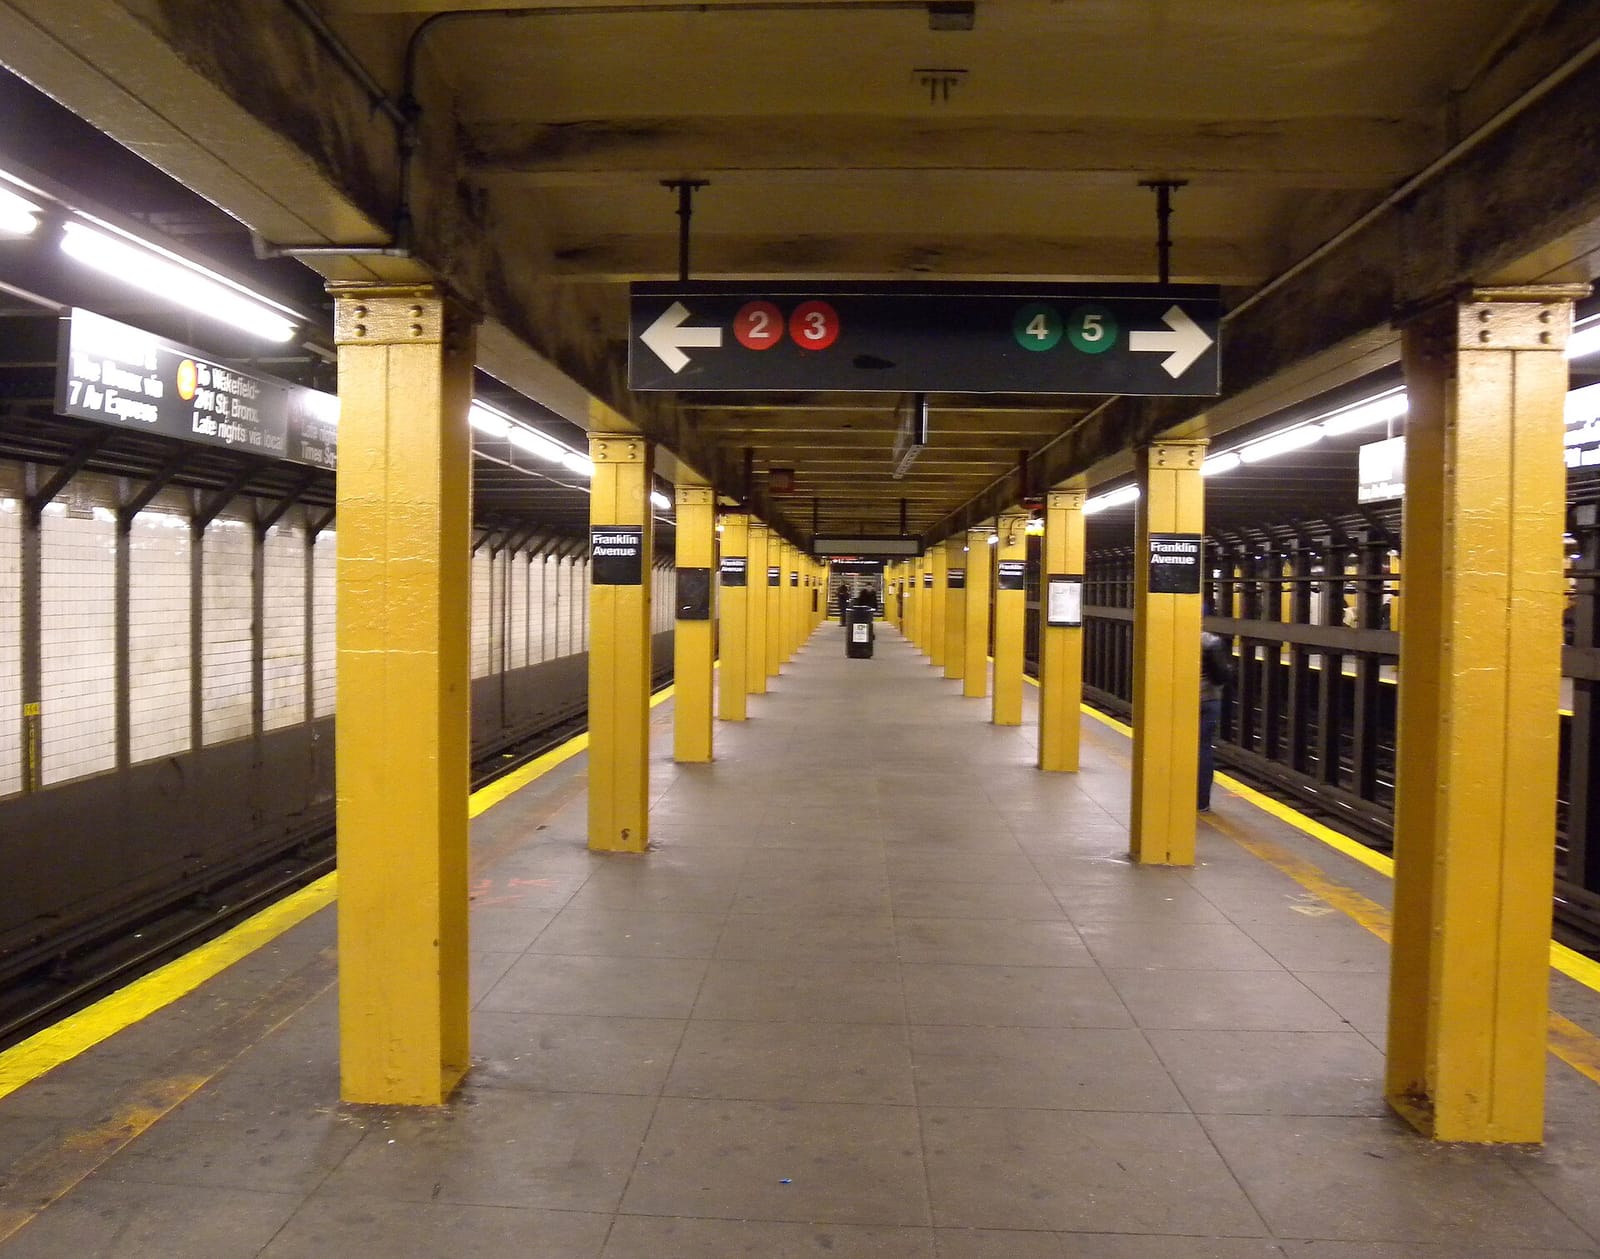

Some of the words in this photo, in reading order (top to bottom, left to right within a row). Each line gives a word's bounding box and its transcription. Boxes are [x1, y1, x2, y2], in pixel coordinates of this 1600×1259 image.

[748, 311, 769, 338] 2
[805, 312, 827, 340] 3
[1025, 314, 1048, 341] 4
[1082, 315, 1104, 342] 5
[196, 363, 211, 386] To
[69, 380, 82, 405] 7
[192, 411, 218, 436] Late
[218, 418, 247, 444] nights
[249, 427, 262, 446] via
[301, 440, 323, 463] Times
[593, 534, 638, 544] Franklin
[1151, 542, 1198, 552] Franklin
[593, 546, 636, 556] Avenue
[1151, 554, 1195, 564] Avenue
